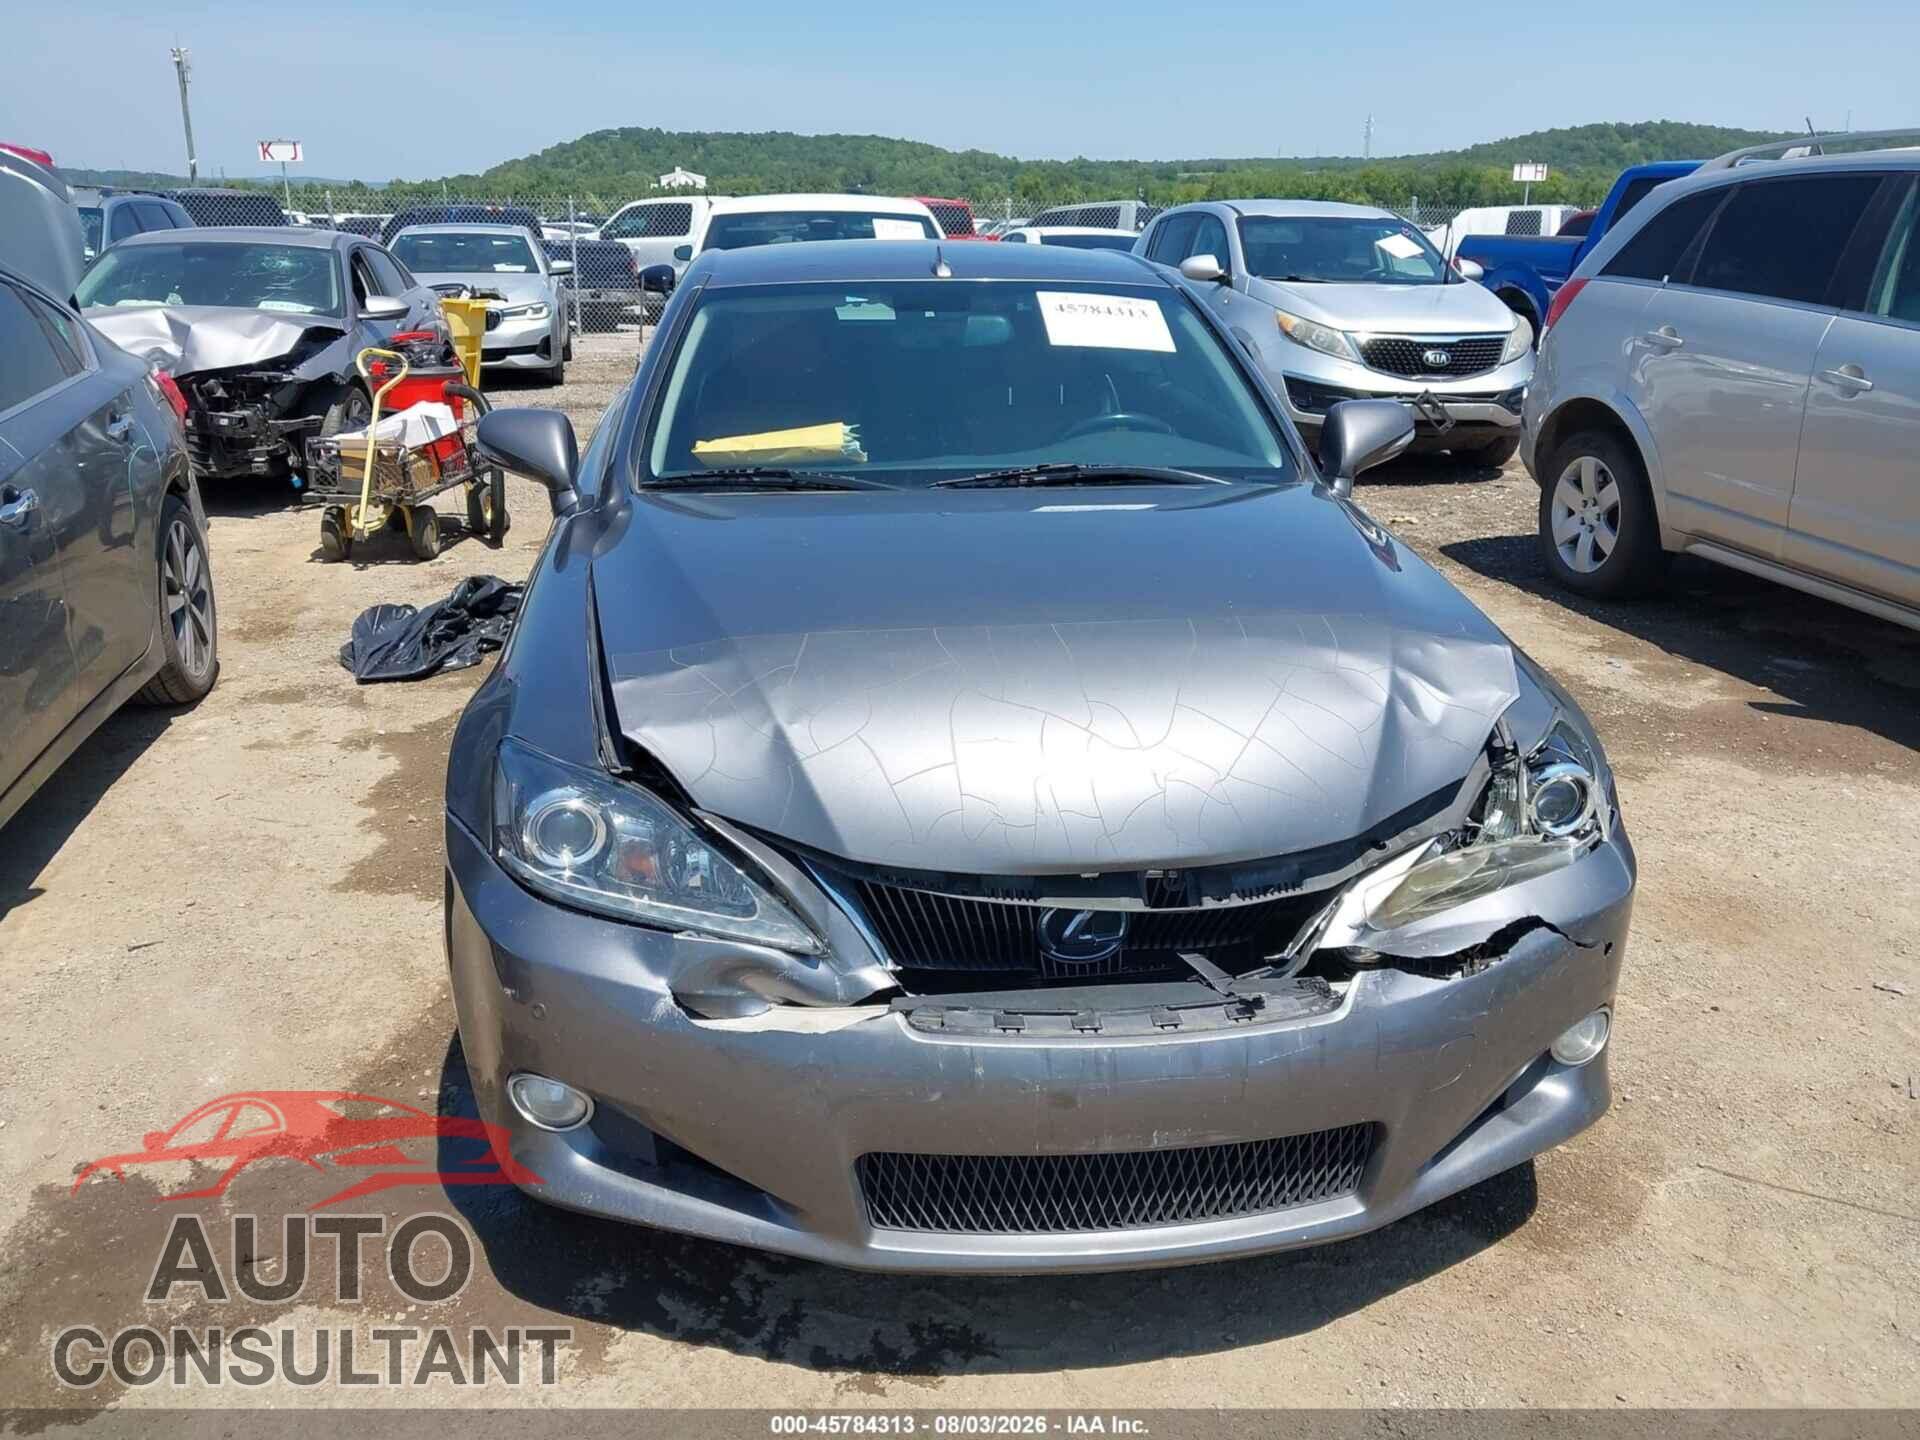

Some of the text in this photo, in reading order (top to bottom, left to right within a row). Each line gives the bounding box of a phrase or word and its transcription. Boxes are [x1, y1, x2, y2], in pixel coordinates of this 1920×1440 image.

[260, 141, 298, 160] K J
[1428, 352, 1447, 364] KIA
